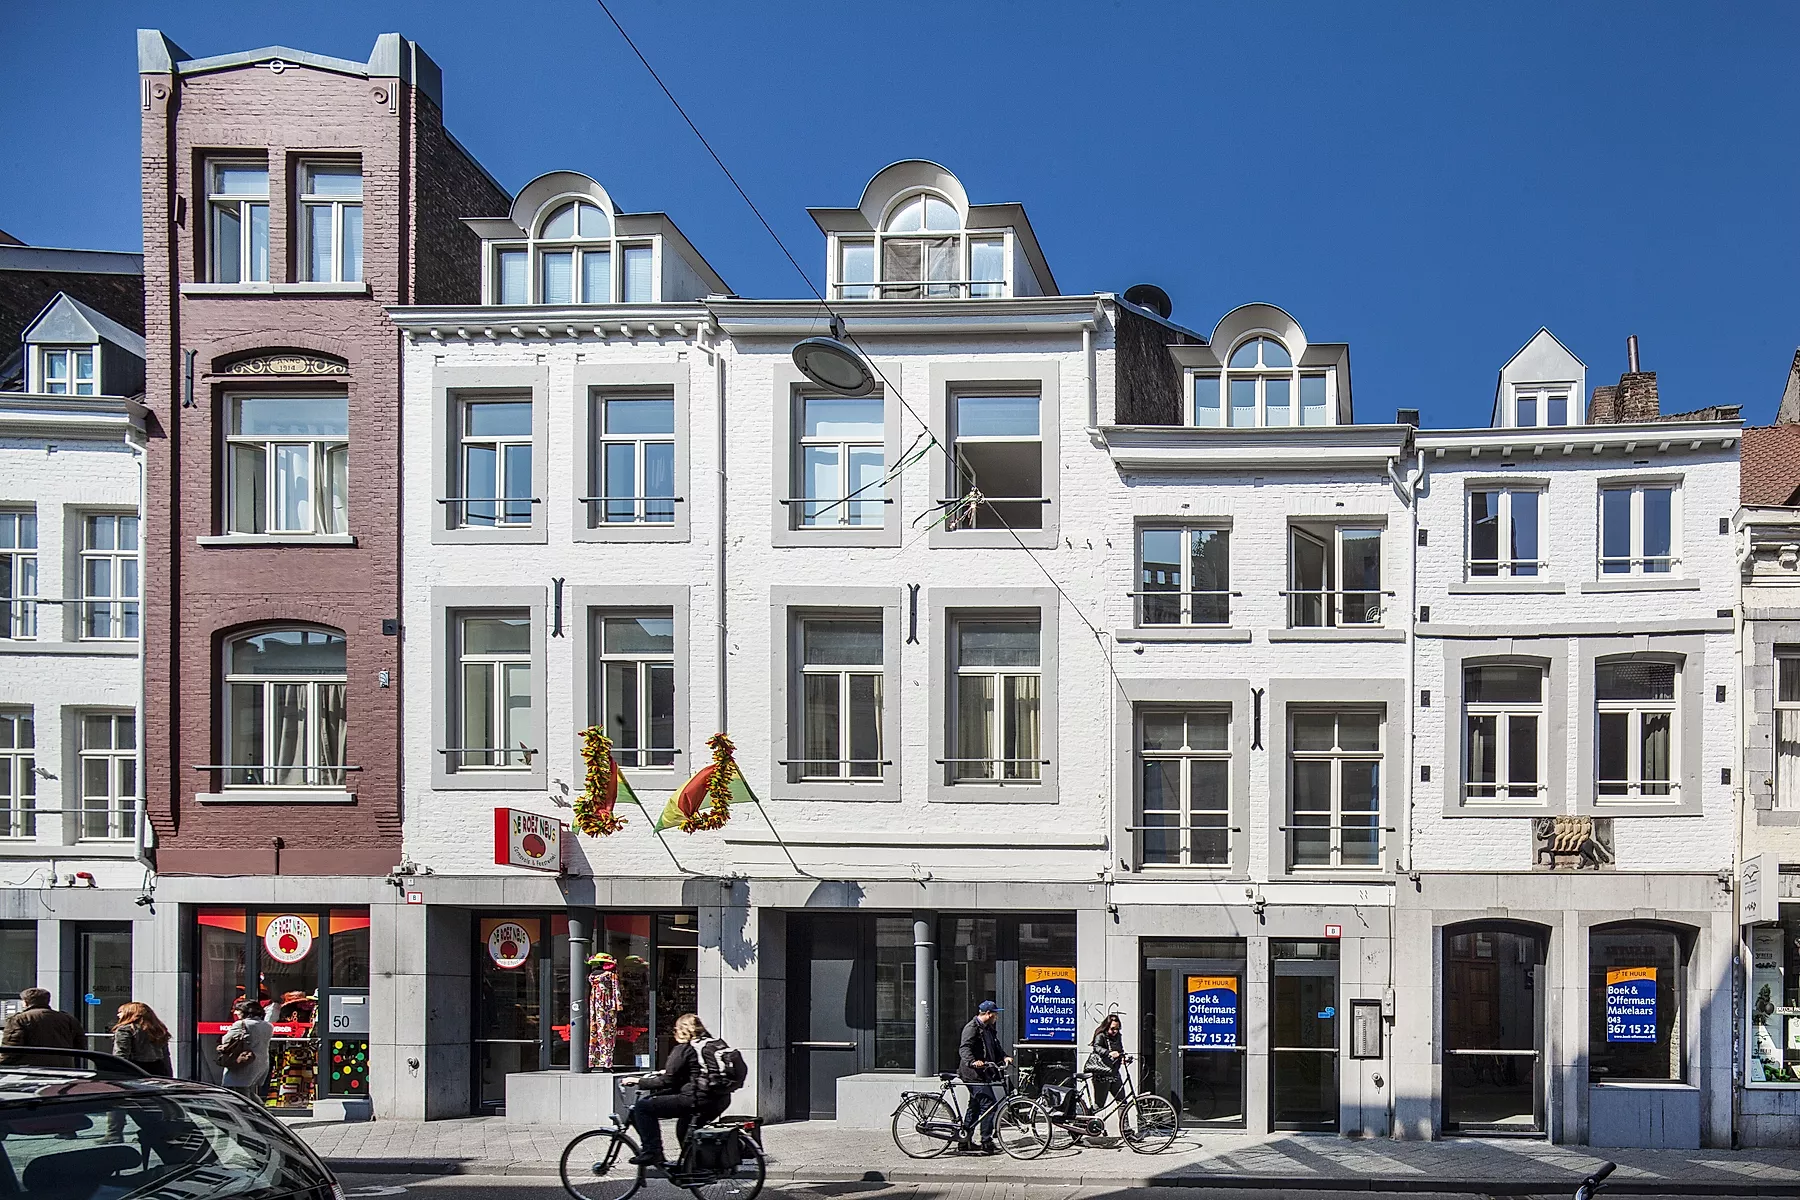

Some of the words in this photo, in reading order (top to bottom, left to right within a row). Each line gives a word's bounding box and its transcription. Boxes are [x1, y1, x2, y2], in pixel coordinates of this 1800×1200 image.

[513, 815, 521, 836] DE
[1030, 984, 1052, 994] Boek
[1053, 985, 1061, 994] &
[1608, 986, 1630, 995] Boek
[1631, 986, 1639, 995] &
[1029, 995, 1076, 1004] Offermans
[1189, 995, 1211, 1004] Boek
[1212, 995, 1219, 1004] &
[1608, 996, 1656, 1005] Offermans
[1029, 1005, 1074, 1014] Makelaars
[1189, 1005, 1236, 1014] Offermans
[1608, 1006, 1653, 1015] Makelaars
[333, 1015, 350, 1028] 50
[1040, 1016, 1054, 1024] 367
[1189, 1015, 1234, 1024] Makelaars
[1607, 1016, 1621, 1024] 043
[1188, 1025, 1202, 1033] 043
[1608, 1024, 1626, 1034] 367
[1629, 1025, 1641, 1034] 15
[1643, 1025, 1656, 1034] 22
[1189, 1033, 1207, 1043] 367
[1209, 1033, 1222, 1043] 15
[1224, 1034, 1236, 1043] 22
